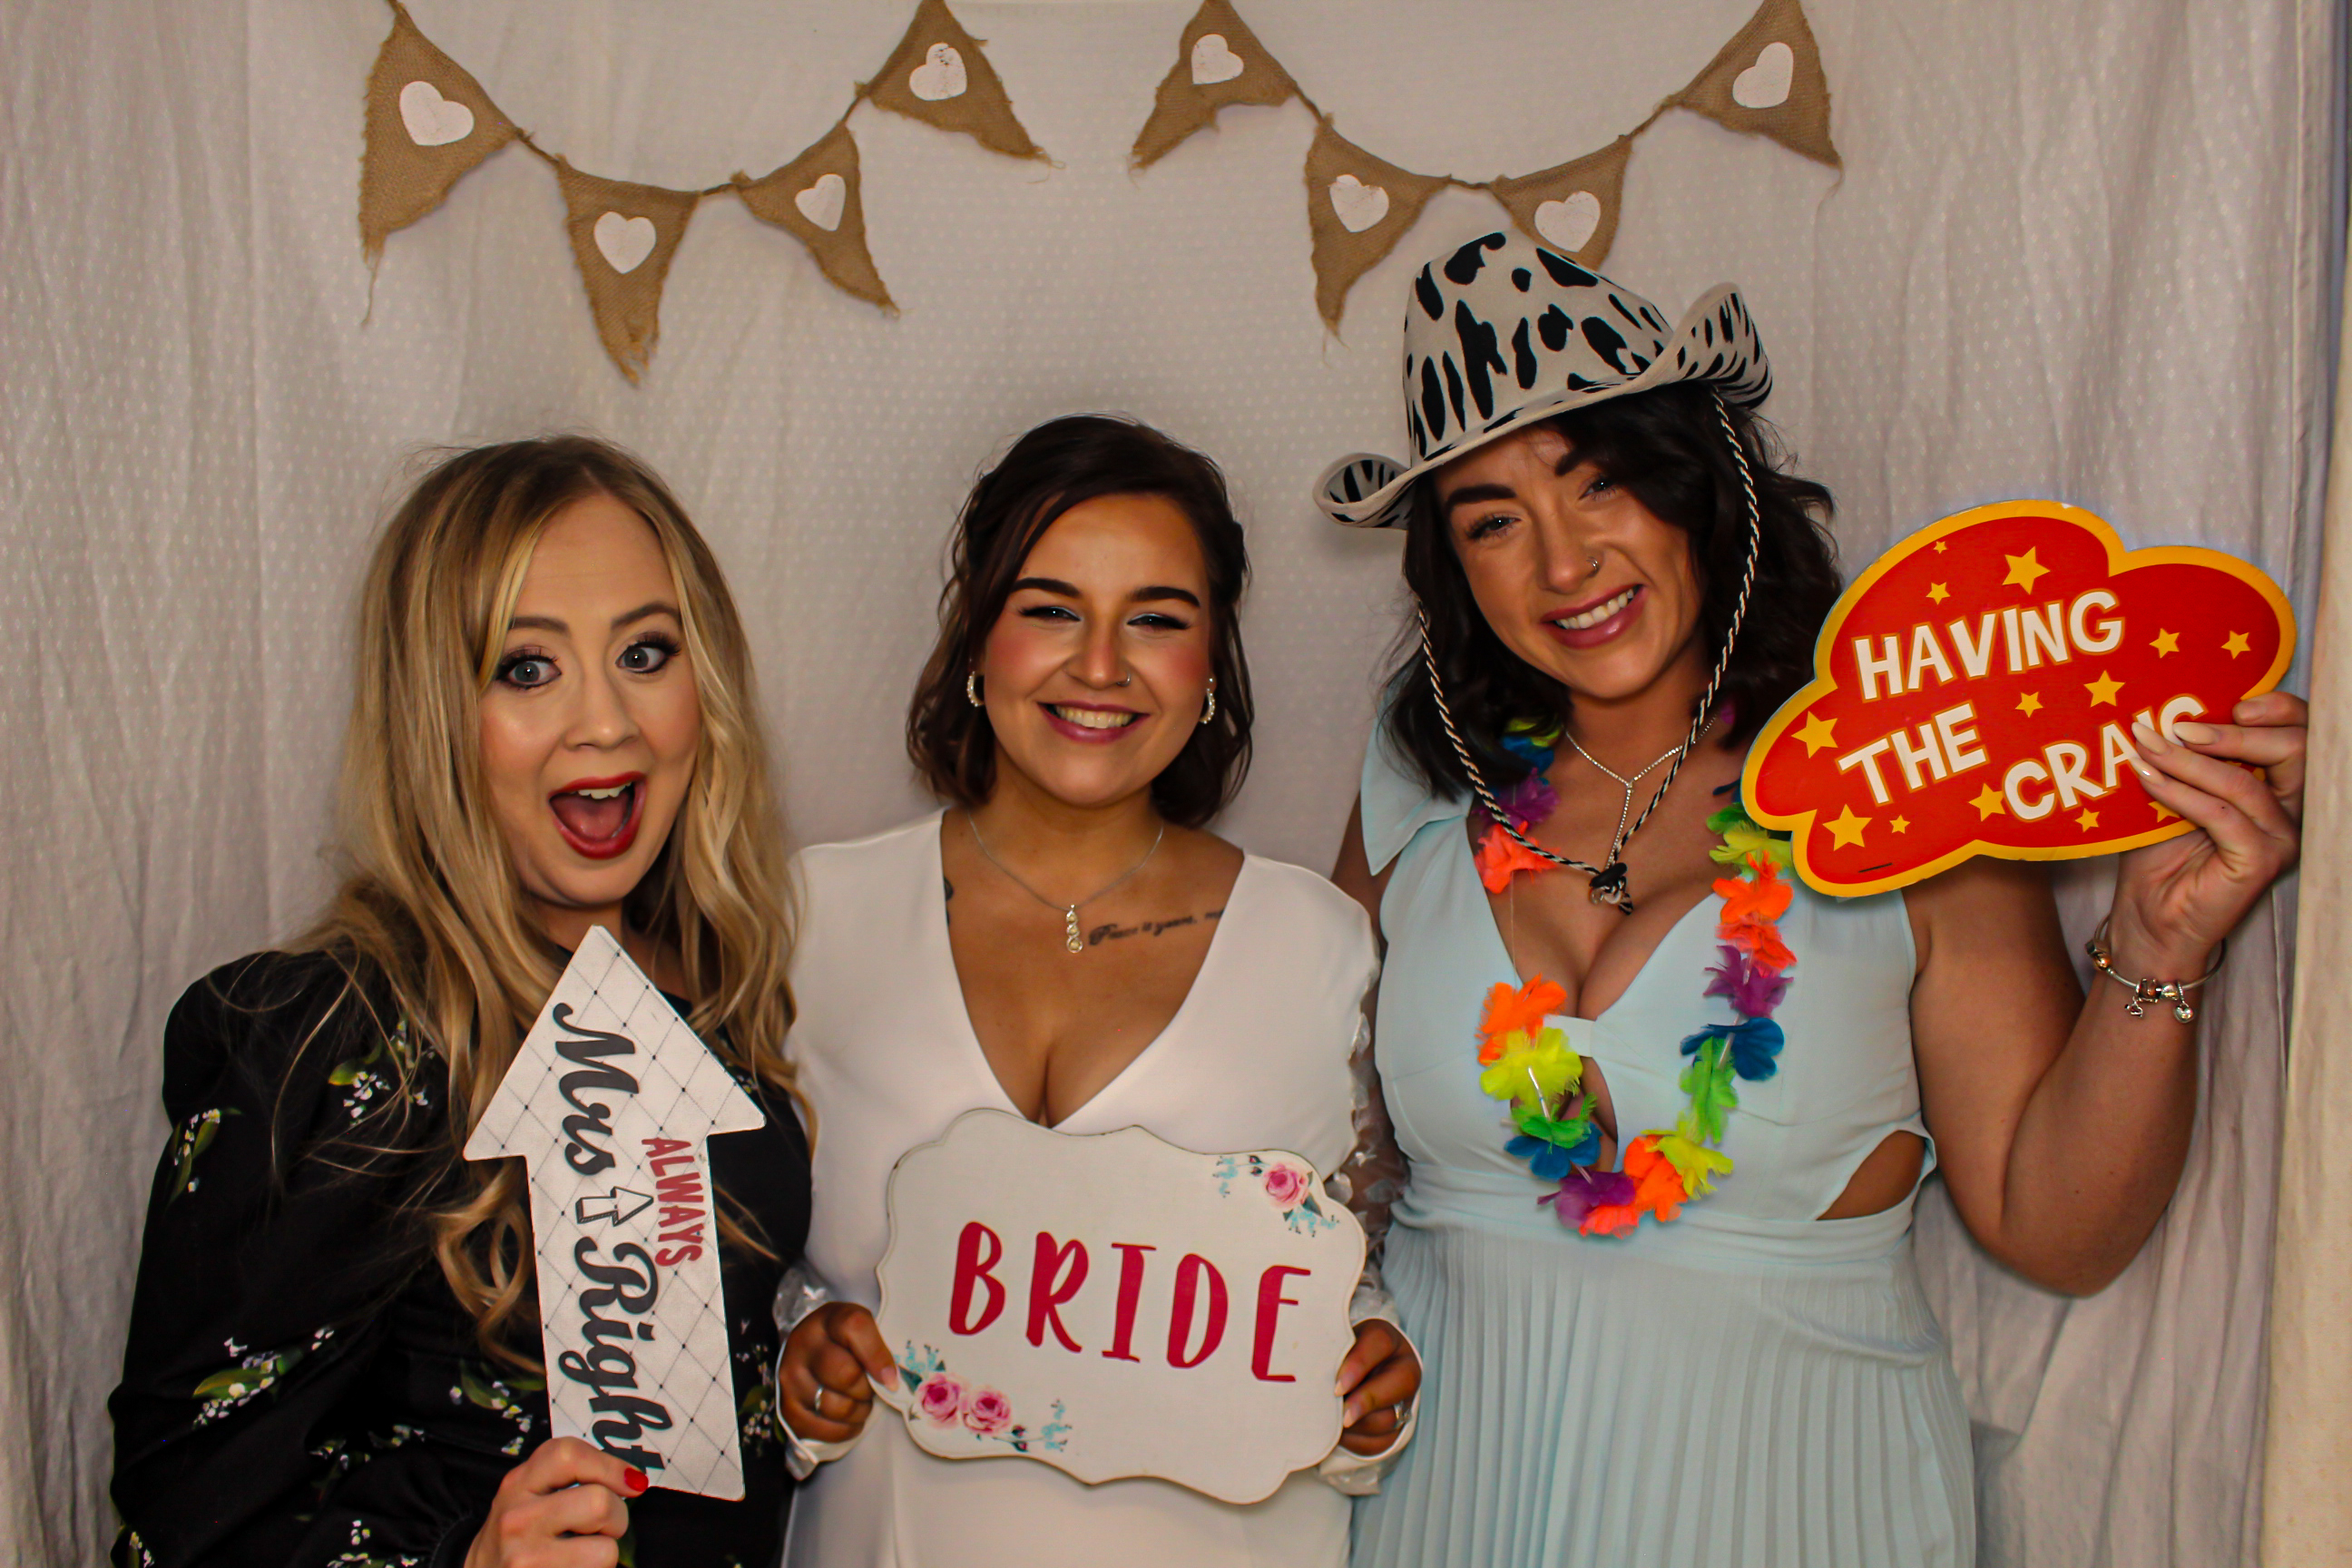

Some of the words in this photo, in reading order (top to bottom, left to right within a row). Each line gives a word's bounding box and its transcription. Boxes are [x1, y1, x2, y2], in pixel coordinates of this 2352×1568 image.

[1854, 590, 2123, 701] HAVING
[1838, 702, 1988, 806] THE
[2004, 695, 2205, 820] CRAC
[552, 1002, 640, 1176] Mrs
[641, 1137, 703, 1267] ALWAYS
[948, 1220, 1311, 1383] BRIDE
